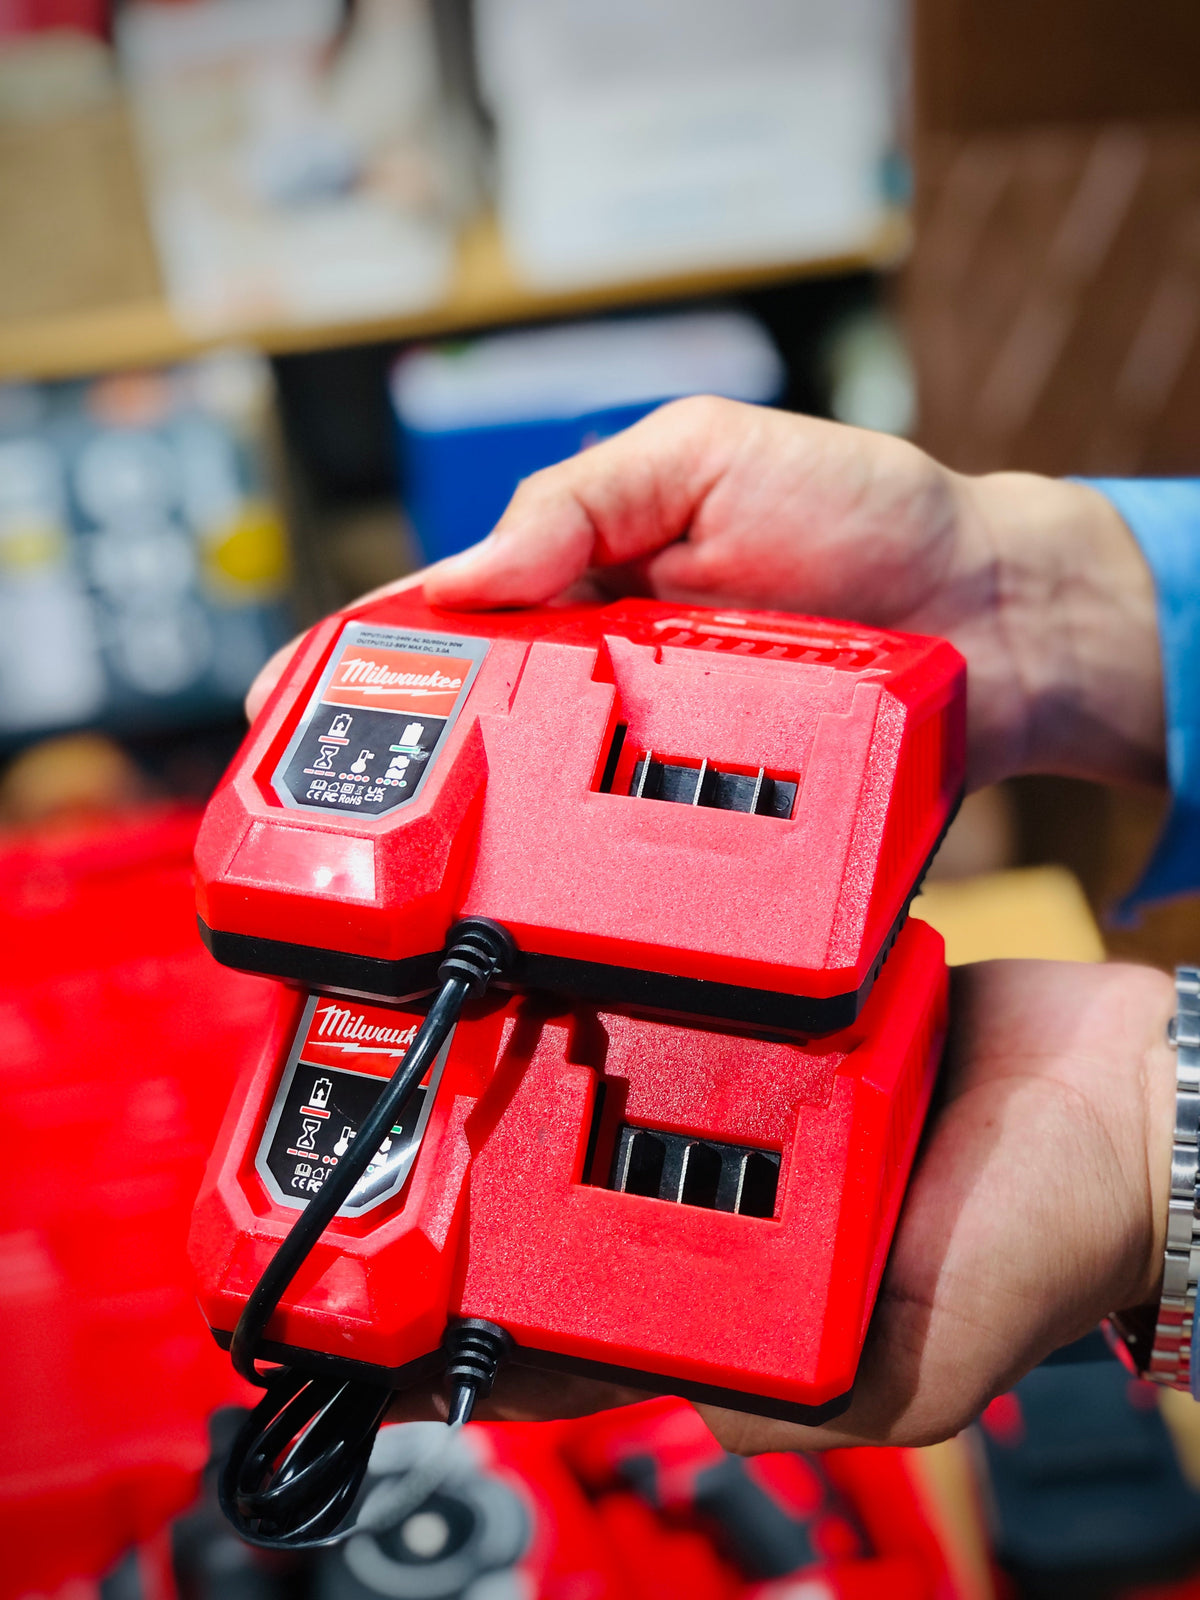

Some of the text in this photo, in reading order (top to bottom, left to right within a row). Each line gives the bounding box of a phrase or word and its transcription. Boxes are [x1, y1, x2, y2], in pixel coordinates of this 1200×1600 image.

[340, 658, 462, 688] Milwaukee
[338, 793, 363, 806] RoHS
[367, 785, 386, 796] UK
[316, 1004, 418, 1045] Milwauk
